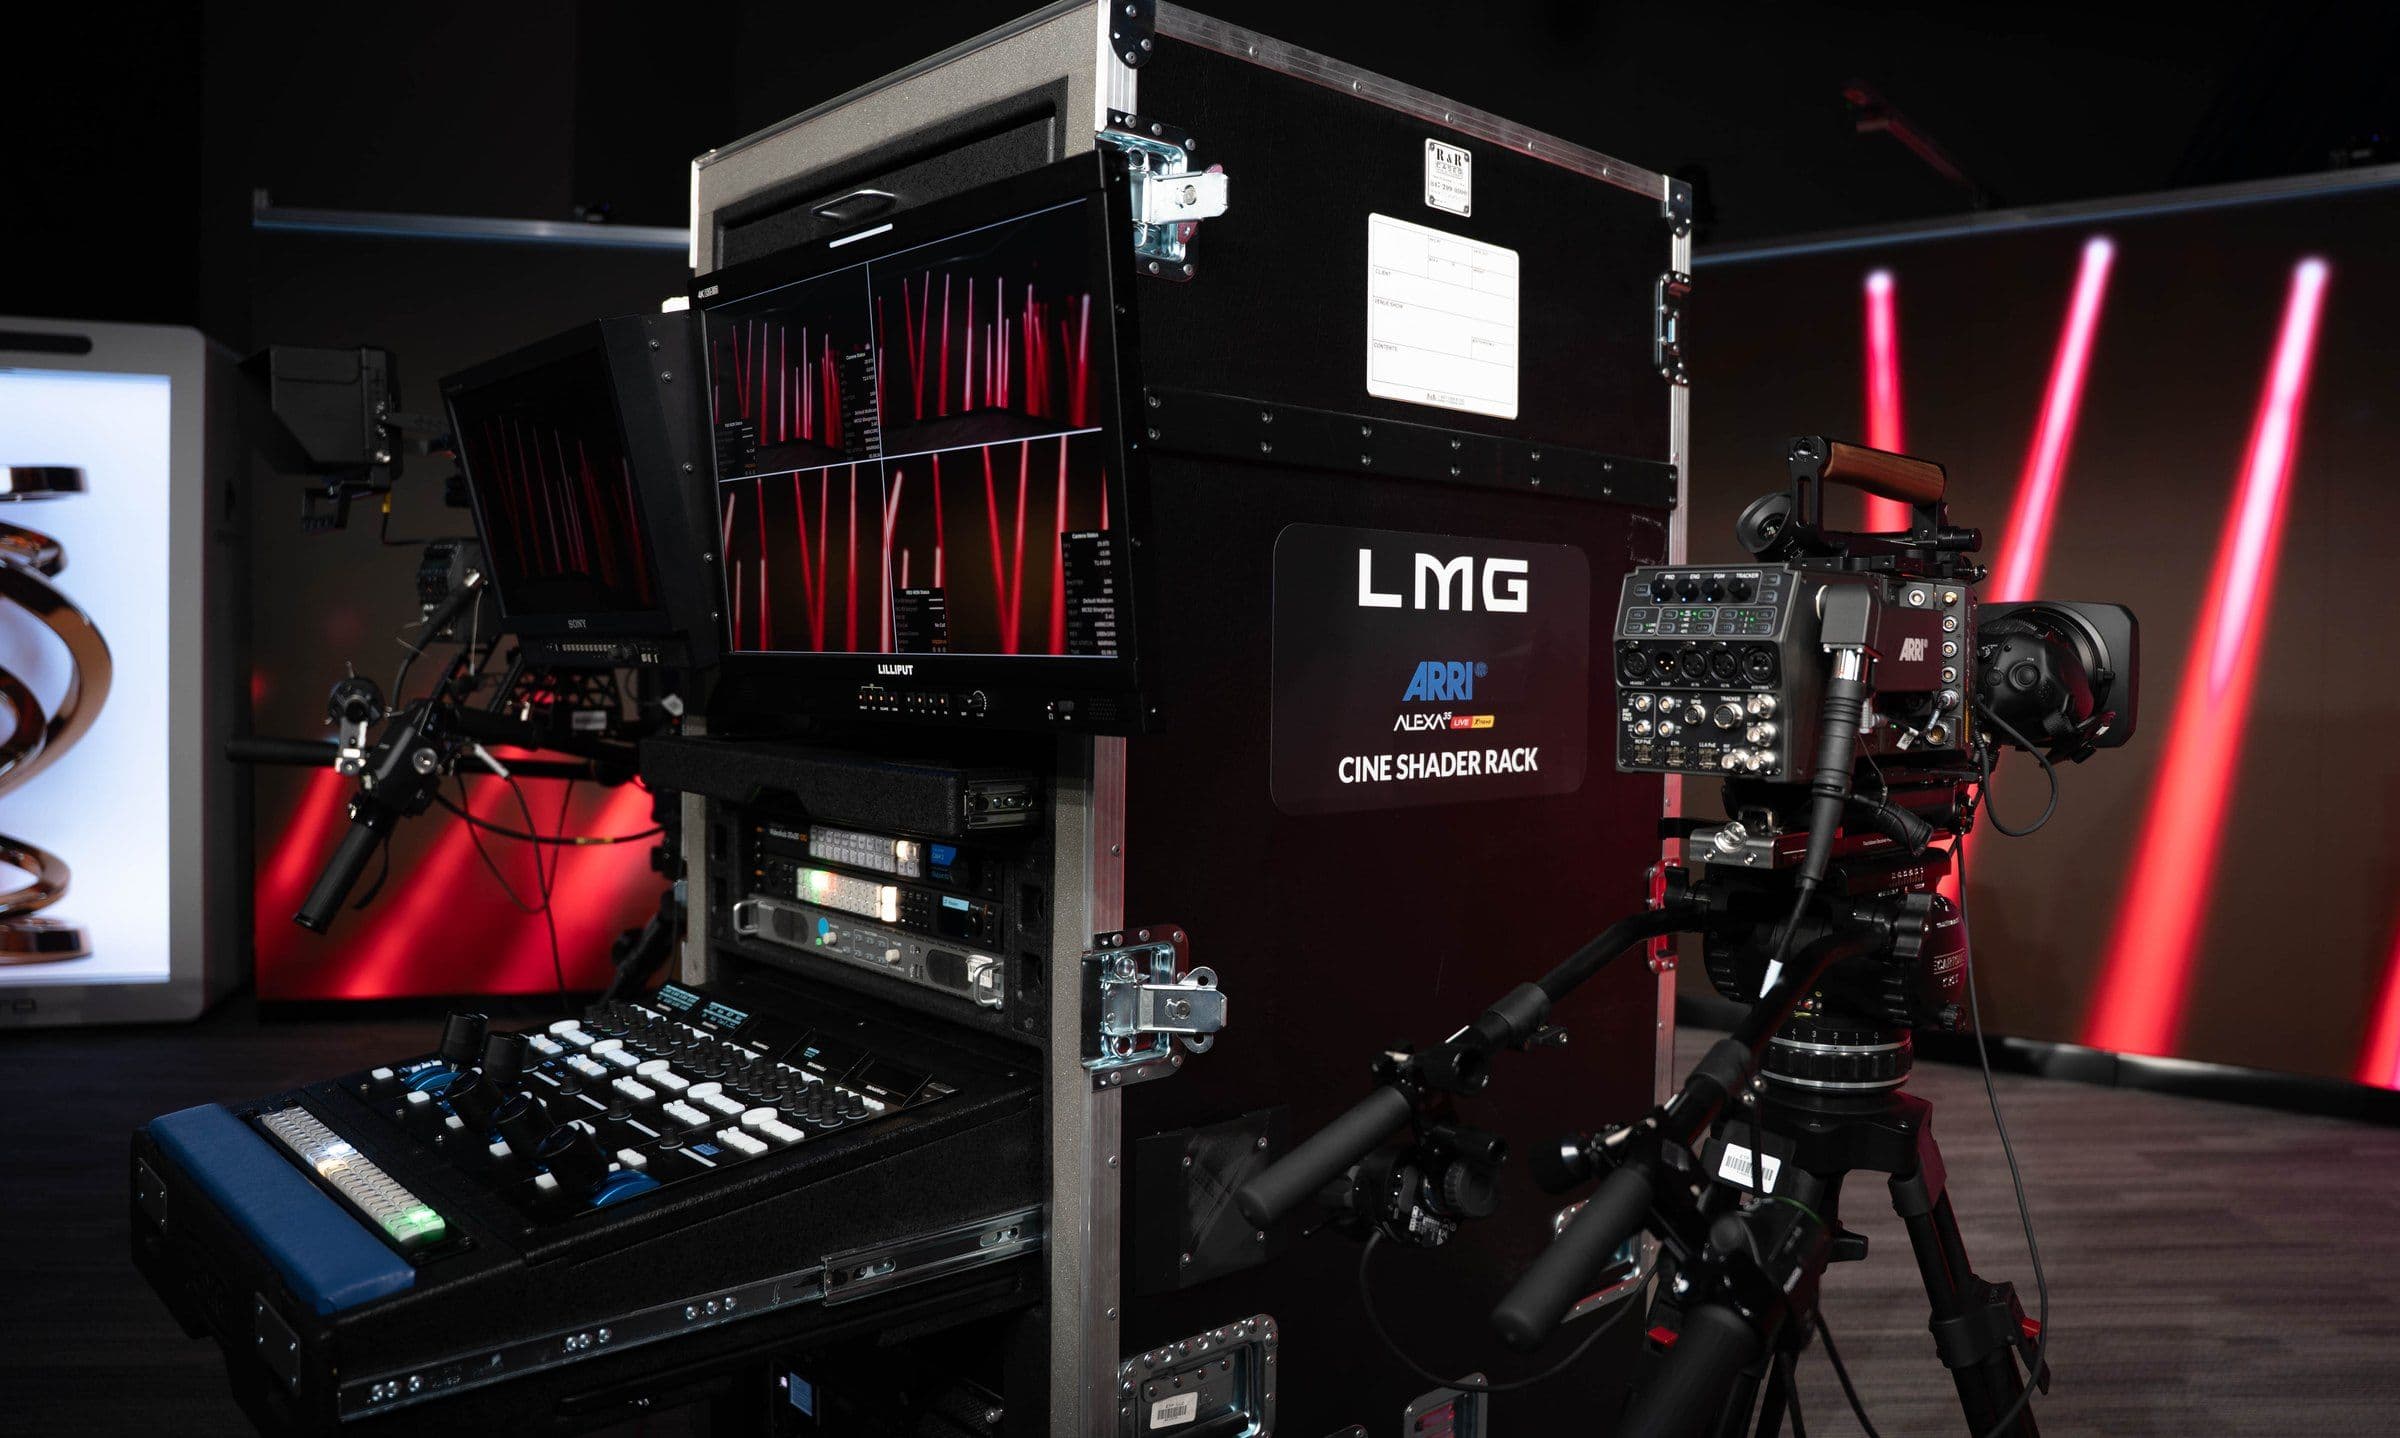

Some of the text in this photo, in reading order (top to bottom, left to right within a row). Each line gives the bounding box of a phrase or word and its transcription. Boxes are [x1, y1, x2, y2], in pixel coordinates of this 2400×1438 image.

[1359, 548, 1529, 613] LMG
[567, 619, 587, 629] SONY
[877, 664, 914, 676] LILLIPUT
[1338, 747, 1539, 783] CINE SHADER RACK
